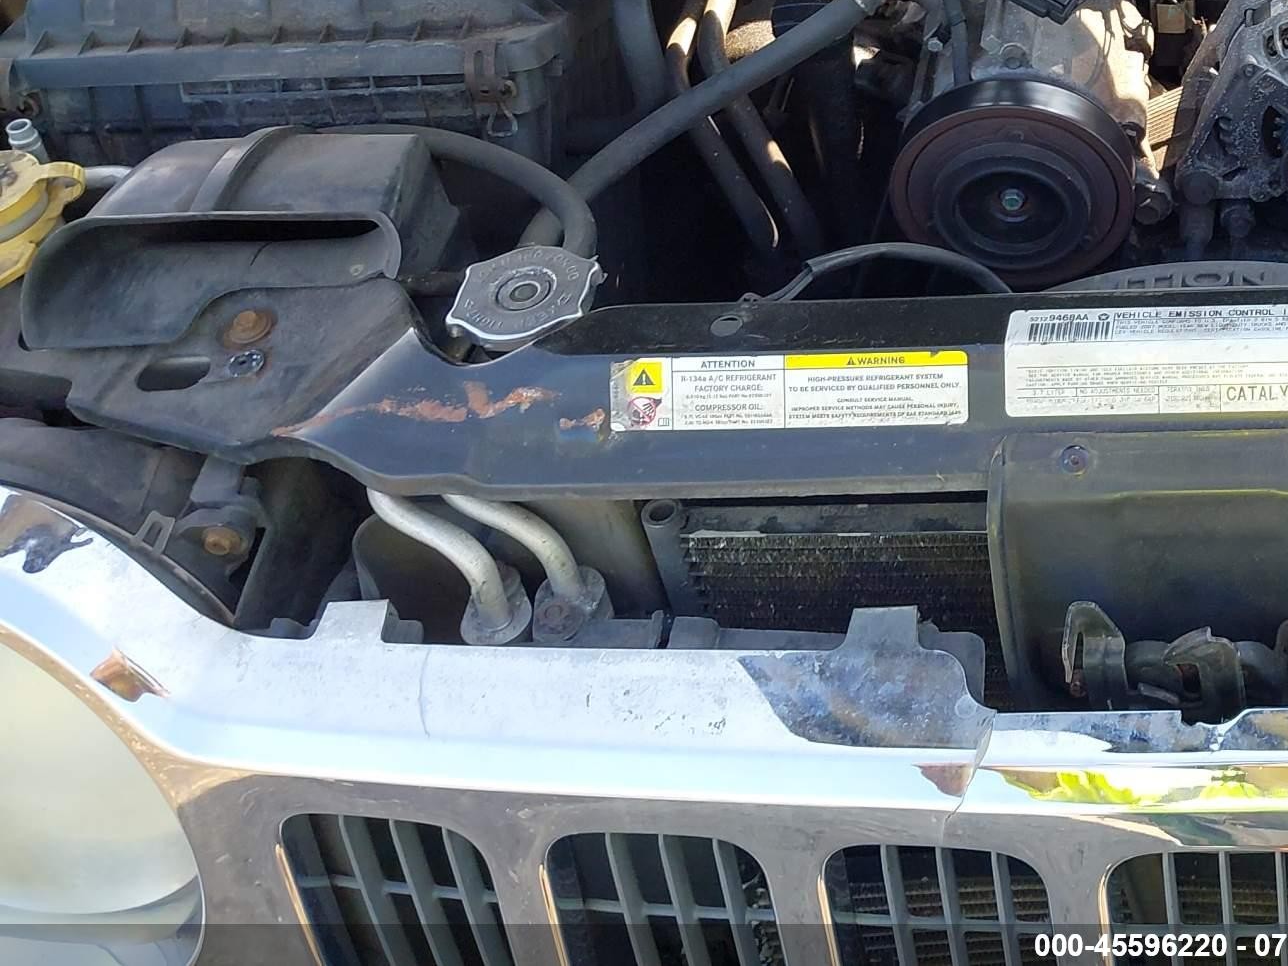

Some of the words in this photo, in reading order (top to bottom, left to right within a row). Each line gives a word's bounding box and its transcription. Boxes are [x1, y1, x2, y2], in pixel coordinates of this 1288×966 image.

[1116, 311, 1161, 319] VEHICLE
[1168, 310, 1223, 318] EMISSION
[1228, 308, 1274, 317] CONTROL
[700, 359, 756, 369] ATTENTION
[857, 356, 906, 365] WARNING
[680, 374, 707, 383] R-134a
[708, 374, 724, 383] A/C
[725, 373, 777, 382] REFRIGERANT
[807, 375, 864, 383] HIGH-PRESSURE
[865, 374, 915, 382] REFRIGERANT
[694, 384, 729, 392] FACTORY
[730, 384, 764, 392] CHARGE:
[857, 384, 896, 392] QUALIFIED
[695, 404, 747, 412] COMPRESSOR
